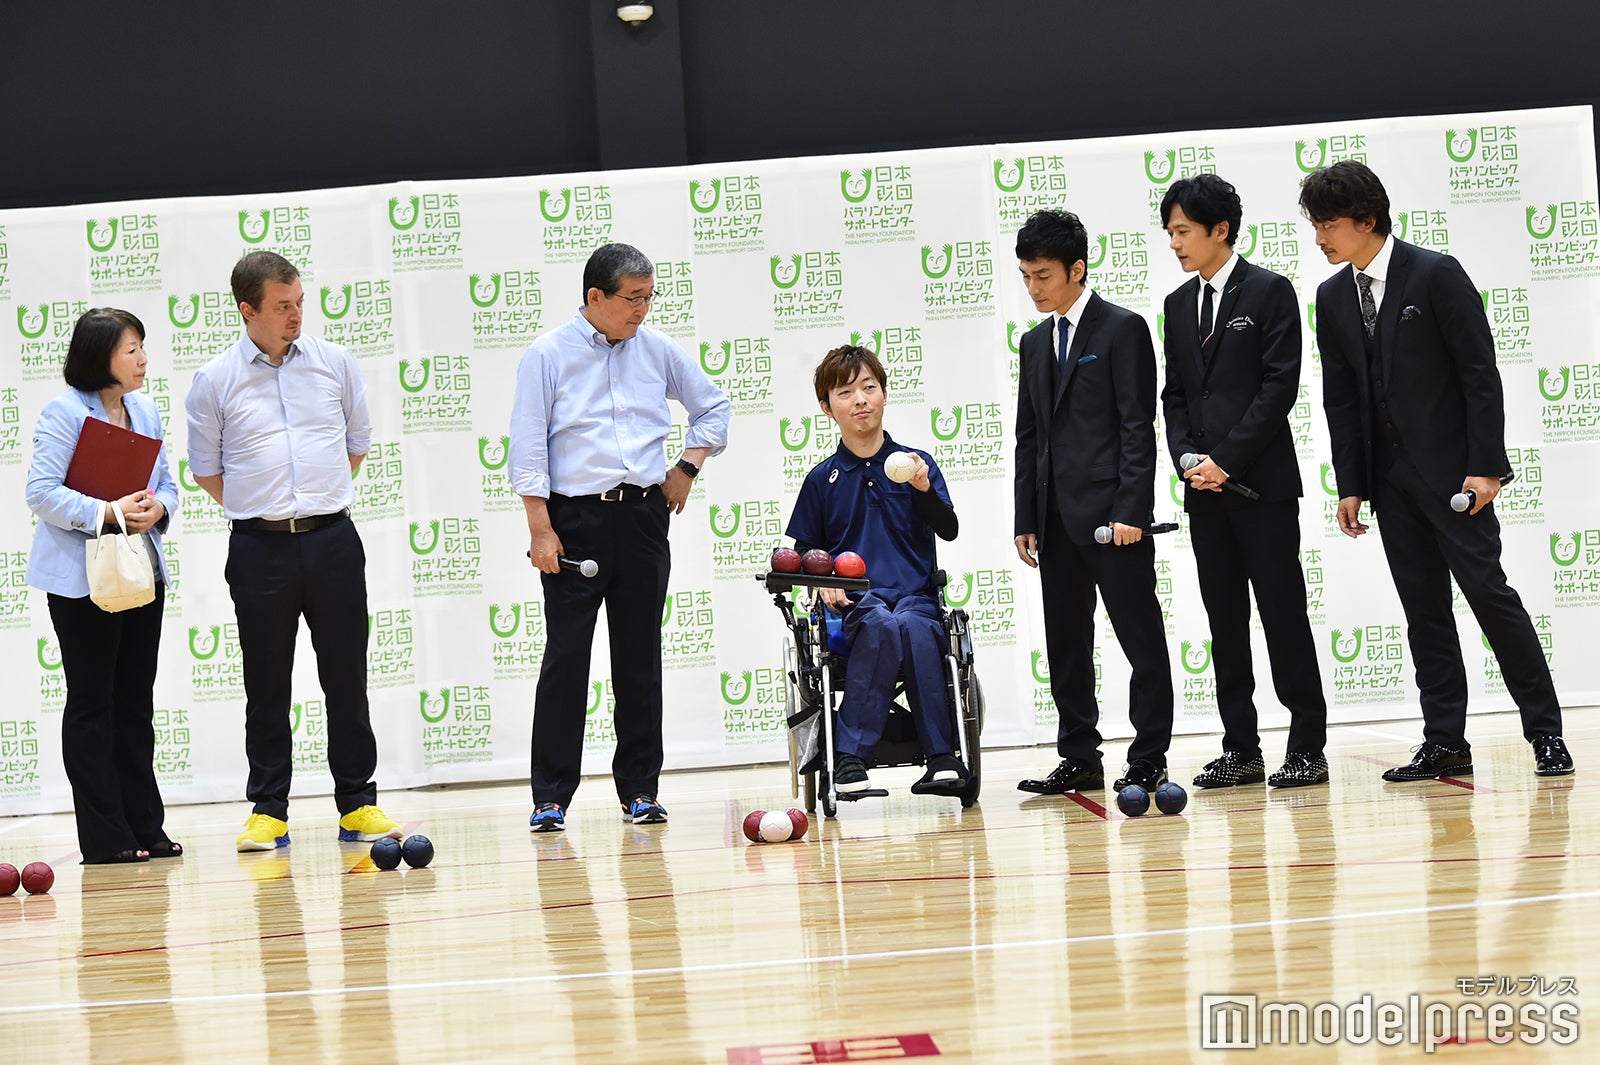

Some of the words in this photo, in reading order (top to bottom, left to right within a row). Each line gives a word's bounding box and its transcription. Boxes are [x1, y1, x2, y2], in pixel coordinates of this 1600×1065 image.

[1480, 126, 1516, 142] 日本
[1330, 135, 1366, 151] 日本
[1179, 146, 1215, 162] 日本
[1028, 156, 1064, 172] 日本
[1449, 164, 1518, 178] パラリンピック
[875, 166, 911, 182] 日本
[724, 176, 760, 192] 日本
[1449, 176, 1519, 190] サポートセンター
[423, 194, 459, 210] 日本
[574, 186, 610, 202] 日本
[997, 194, 1066, 208] パラリンピック
[273, 207, 309, 223] 日本
[844, 204, 912, 218] パラリンピック
[1561, 202, 1597, 218] 日本
[121, 215, 157, 231] 日本
[693, 214, 762, 228] パラリンピック
[844, 216, 914, 230] サポートセンター
[1411, 211, 1447, 227] 日本
[543, 224, 612, 238] パラリンピック
[693, 226, 763, 240] サポートセンター
[1261, 221, 1297, 237] 日本
[392, 232, 460, 246] パラリンピック
[1110, 232, 1146, 248] 日本
[1530, 240, 1598, 254] パラリンピック
[392, 244, 462, 258] サポートセンター
[955, 242, 991, 258] 日本
[90, 252, 158, 268] パラリンピック
[804, 252, 840, 268] 日本
[1530, 252, 1600, 266] サポートセンター
[90, 266, 160, 280] サポートセンター
[655, 262, 691, 278] 日本
[504, 271, 540, 287] 日本
[924, 280, 992, 294] パラリンピック
[355, 281, 391, 297] 日本
[773, 290, 842, 304] パラリンピック
[1492, 288, 1528, 304] 日本
[924, 292, 994, 306] サポートセンター
[473, 308, 542, 324] パラリンピック
[773, 302, 843, 316] サポートセンター
[324, 318, 392, 334] パラリンピック
[473, 322, 543, 336] サポートセンター
[172, 330, 240, 344] パラリンピック
[885, 328, 921, 344] 日本
[734, 338, 770, 354] 日本
[433, 356, 469, 372] 日本
[402, 394, 470, 408] パラリンピック
[402, 406, 472, 420] サポートセンター
[965, 404, 1001, 420] 日本
[365, 443, 401, 459] 日本
[934, 442, 1002, 456] パラリンピック
[934, 454, 1004, 468] サポートセンター
[744, 500, 780, 516] 日本
[443, 517, 479, 533] 日本
[412, 554, 480, 570] パラリンピック
[412, 568, 482, 582] サポートセンター
[976, 570, 1012, 586] 日本
[676, 590, 712, 606] 日本
[376, 610, 412, 626] 日本
[1365, 625, 1401, 641] 日本
[1334, 662, 1402, 678] パラリンピック
[1334, 676, 1404, 690] サポートセンター
[453, 686, 489, 702] 日本
[153, 710, 189, 726] 日本
[0, 720, 36, 736] 日本
[422, 724, 490, 738] パラリンピック
[422, 736, 492, 750] サポートセンター
